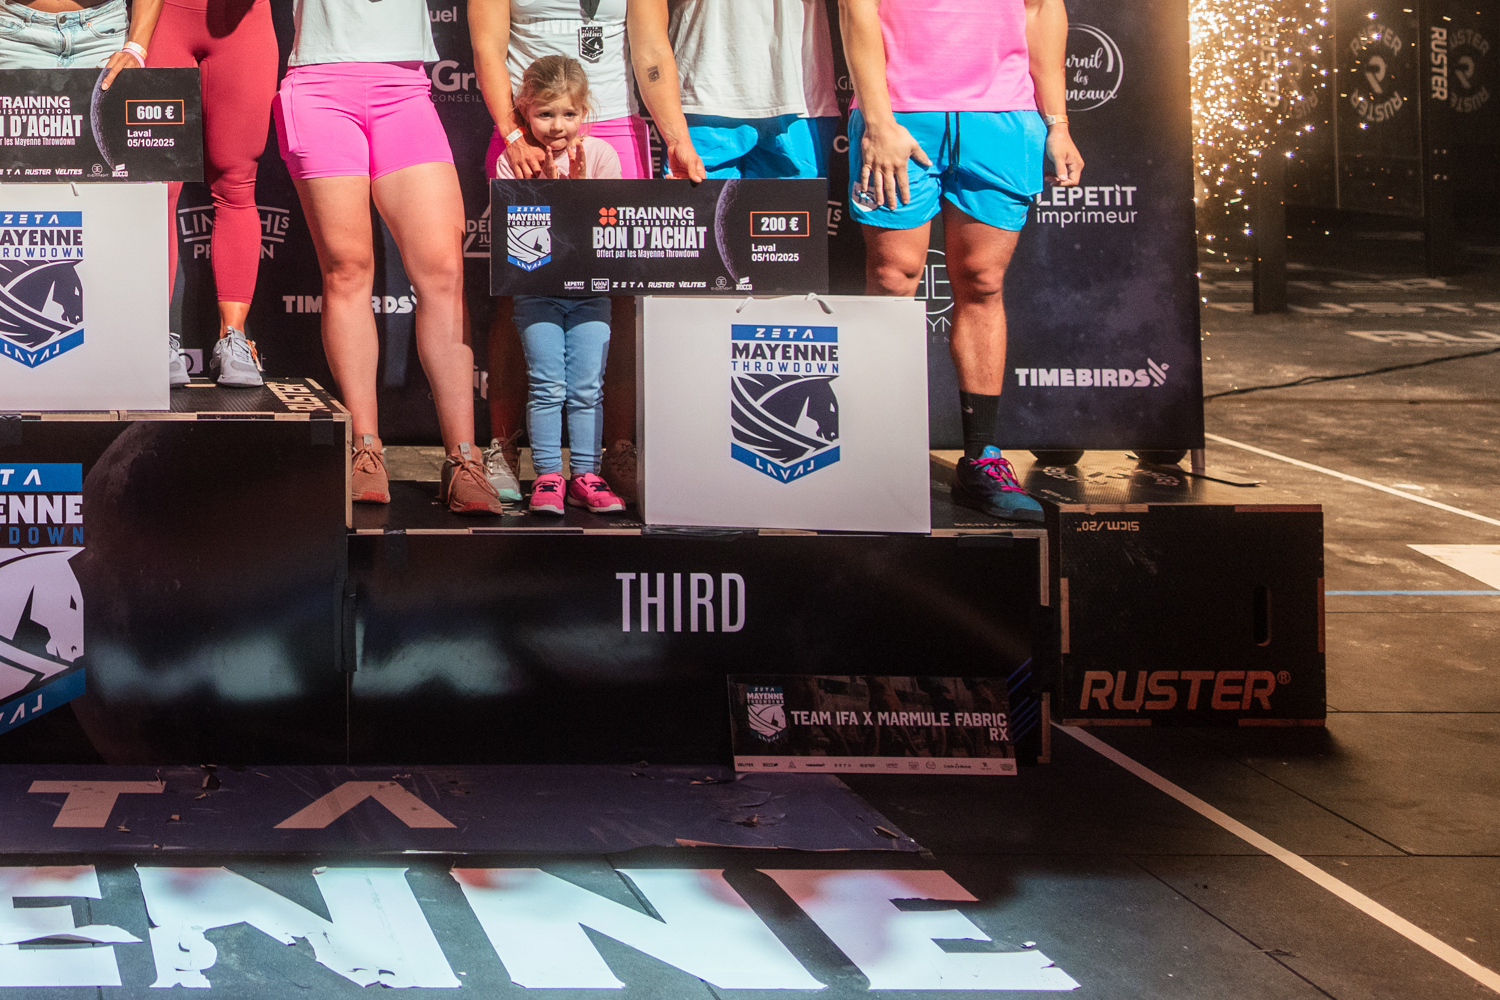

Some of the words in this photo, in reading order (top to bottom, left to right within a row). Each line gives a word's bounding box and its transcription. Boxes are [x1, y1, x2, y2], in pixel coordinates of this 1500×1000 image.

[1431, 26, 1448, 100] RUSTER
[1074, 70, 1089, 85] des
[137, 105, 162, 120] 600
[165, 105, 175, 120] €
[127, 129, 151, 137] Laval
[4, 137, 13, 146] les
[15, 137, 41, 147] Mayenne
[42, 137, 76, 146] Throwdown
[127, 139, 175, 148] 05/10/2025
[55, 168, 83, 176] VELITES
[1037, 185, 1137, 206] LEPETIT
[3, 214, 60, 224] ZETA
[507, 213, 551, 221] MAYENNE
[617, 206, 694, 219] TRAINING
[1037, 207, 1138, 227] imprimeur
[761, 217, 786, 231] 200
[789, 217, 799, 231] €
[593, 226, 631, 249] BON
[597, 249, 614, 258] Offert
[616, 250, 626, 259] par
[627, 249, 637, 258] les
[638, 249, 665, 259] Mayenne
[666, 249, 699, 258] Throwdown
[752, 244, 776, 252] Laval
[752, 253, 799, 262] 05/10/2025
[755, 328, 814, 339] ZETA
[732, 343, 839, 362] MAYENNE
[731, 361, 839, 374] THROWDOWN
[1015, 367, 1149, 387] TIMEBIRDS
[616, 572, 746, 633] THIRD
[747, 692, 783, 700] MAYENNE
[791, 711, 831, 725] TEAM
[836, 711, 858, 725] IFA
[863, 712, 873, 725] X
[878, 712, 950, 727] MARMULE
[954, 712, 1007, 727] FABRIC
[989, 727, 1009, 741] RX
